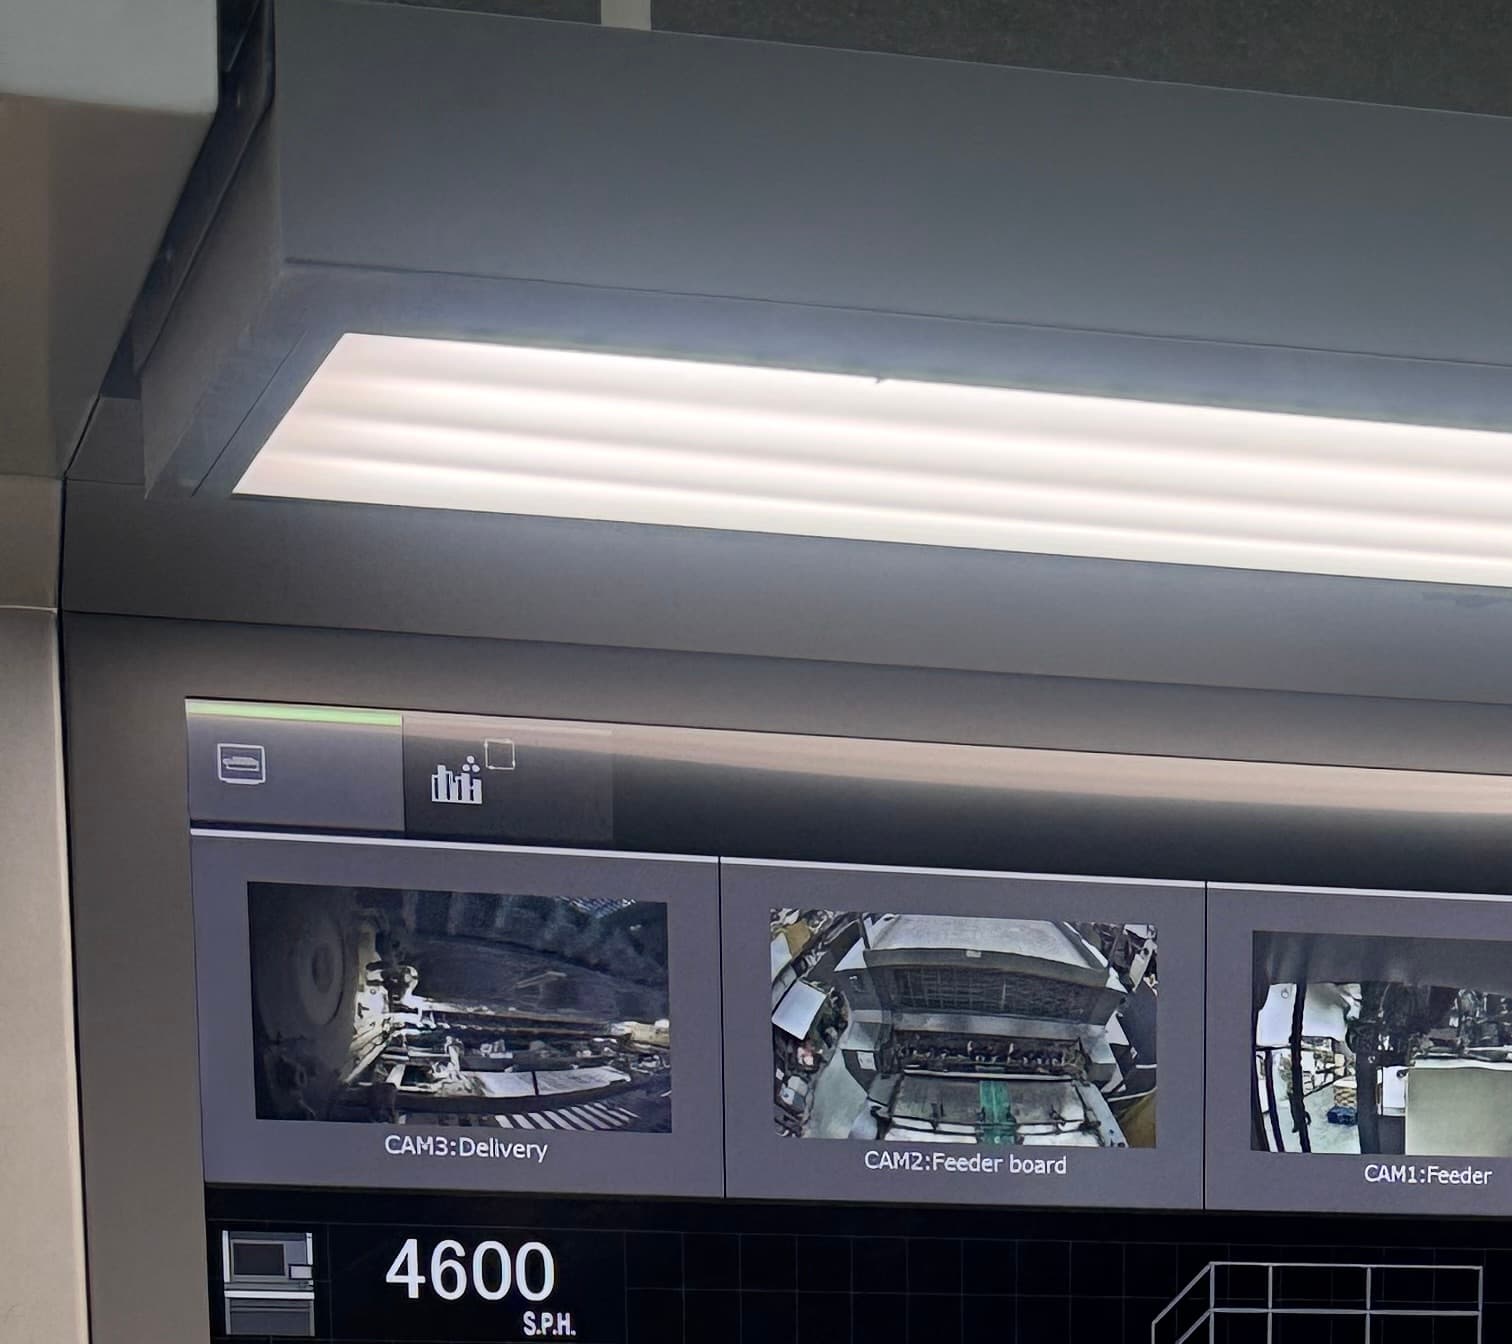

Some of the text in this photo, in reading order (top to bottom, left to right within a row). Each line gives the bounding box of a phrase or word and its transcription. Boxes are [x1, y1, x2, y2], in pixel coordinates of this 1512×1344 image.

[384, 1134, 548, 1162] CAM3:Delivery
[864, 1149, 1068, 1175] CAM2:Feeder board
[1364, 1163, 1493, 1186] CAM1:Feeder
[385, 1238, 555, 1301] 4600
[523, 1311, 577, 1336] S.P.H.
